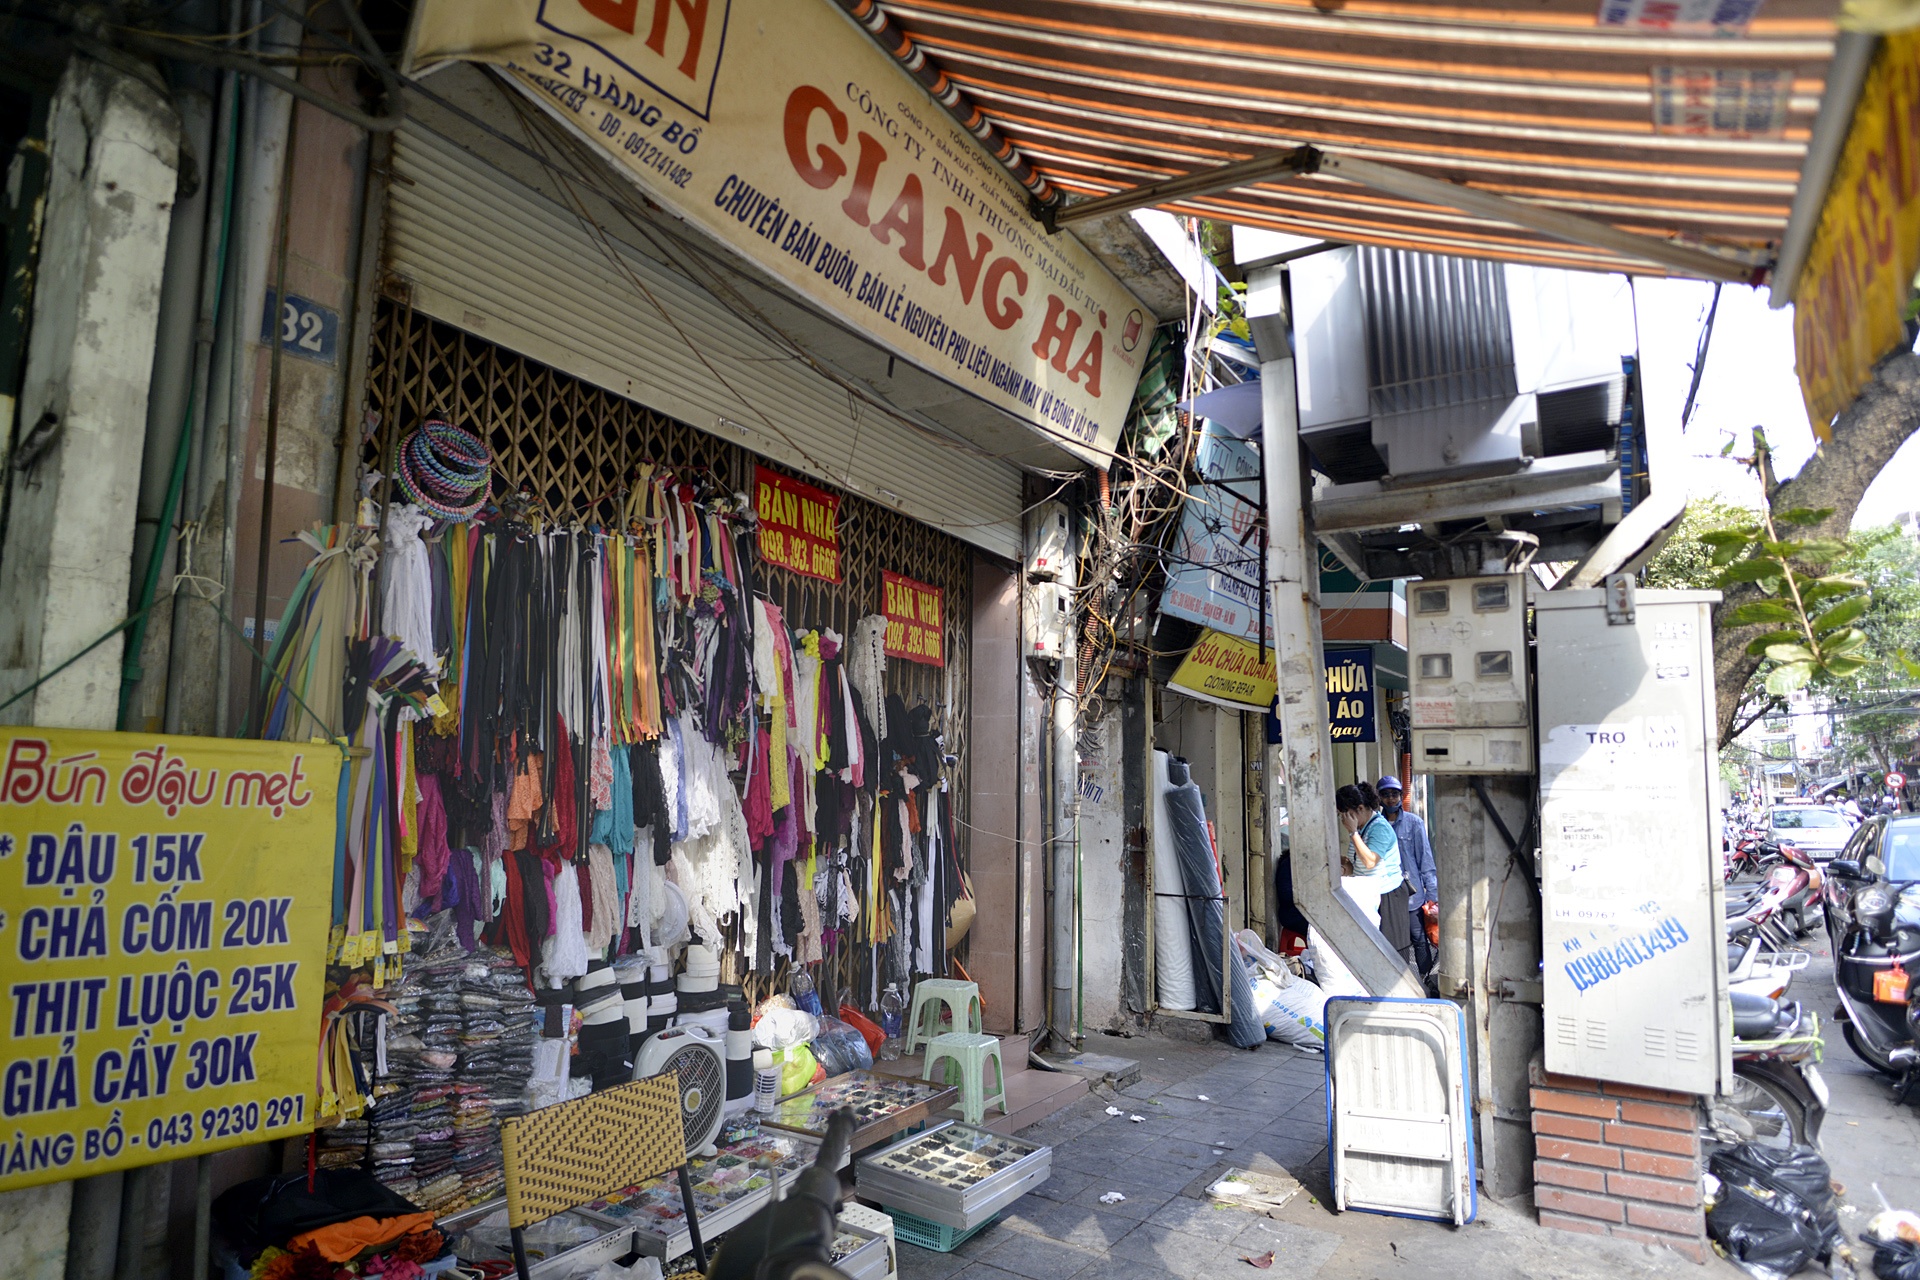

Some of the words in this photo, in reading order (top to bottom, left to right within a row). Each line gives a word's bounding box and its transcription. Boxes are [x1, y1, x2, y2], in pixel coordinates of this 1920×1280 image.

[534, 42, 573, 79] 32
[582, 66, 662, 127] HÀNG
[897, 101, 923, 130] CÔNG
[924, 126, 935, 140] TY
[846, 81, 899, 138] CÔNG
[904, 132, 927, 162] TY
[932, 156, 975, 207] TNHH
[978, 200, 1034, 259] THƯƠNG
[993, 172, 1003, 184] TY
[783, 85, 1028, 331] GIANG
[1032, 294, 1107, 398] HÀ
[714, 174, 789, 243] CHUYÊN
[781, 221, 821, 266] BÁN
[814, 242, 858, 298] BUÔN,
[856, 272, 889, 313] BÁN
[884, 284, 906, 323] LẺ
[901, 300, 949, 351] NGUYÊN
[945, 330, 970, 370] PHỤ
[966, 344, 993, 379] LIỆU
[988, 358, 1021, 396] NGÀNH
[1018, 378, 1042, 410] MAY
[1041, 391, 1054, 417] VÀ
[1071, 408, 1088, 436] VẢI
[759, 480, 798, 529] BÁN
[802, 499, 837, 543] NHÀ
[812, 543, 837, 580] 6666
[885, 577, 915, 620] BÁN
[916, 590, 940, 627] NHÀ
[924, 628, 940, 659] 6666
[1192, 636, 1220, 666] SỬA
[1216, 647, 1247, 674] CHỮA
[1203, 674, 1236, 694] CLOTHING
[1235, 681, 1256, 697] REPAIR
[1336, 697, 1365, 719] ÁO
[1586, 731, 1626, 748] TRỌ
[1, 739, 107, 804] Bún
[121, 746, 217, 817] đậu
[224, 756, 312, 818] mẹt
[26, 824, 117, 896] ĐẬU
[132, 834, 205, 884] 15K
[19, 889, 107, 960] CHẢ
[122, 885, 212, 954] CỐM
[222, 898, 292, 948] 20K
[12, 978, 107, 1045] THỊT
[117, 962, 219, 1033] LUỘC
[228, 963, 298, 1015] 25K
[4, 1039, 78, 1117] GIẢ
[94, 1029, 176, 1104] CẦY
[185, 1033, 258, 1089] 30K
[84, 1110, 125, 1161] BỒ
[147, 1113, 194, 1150] 043
[202, 1102, 259, 1141] 9230
[266, 1093, 304, 1127] 291
